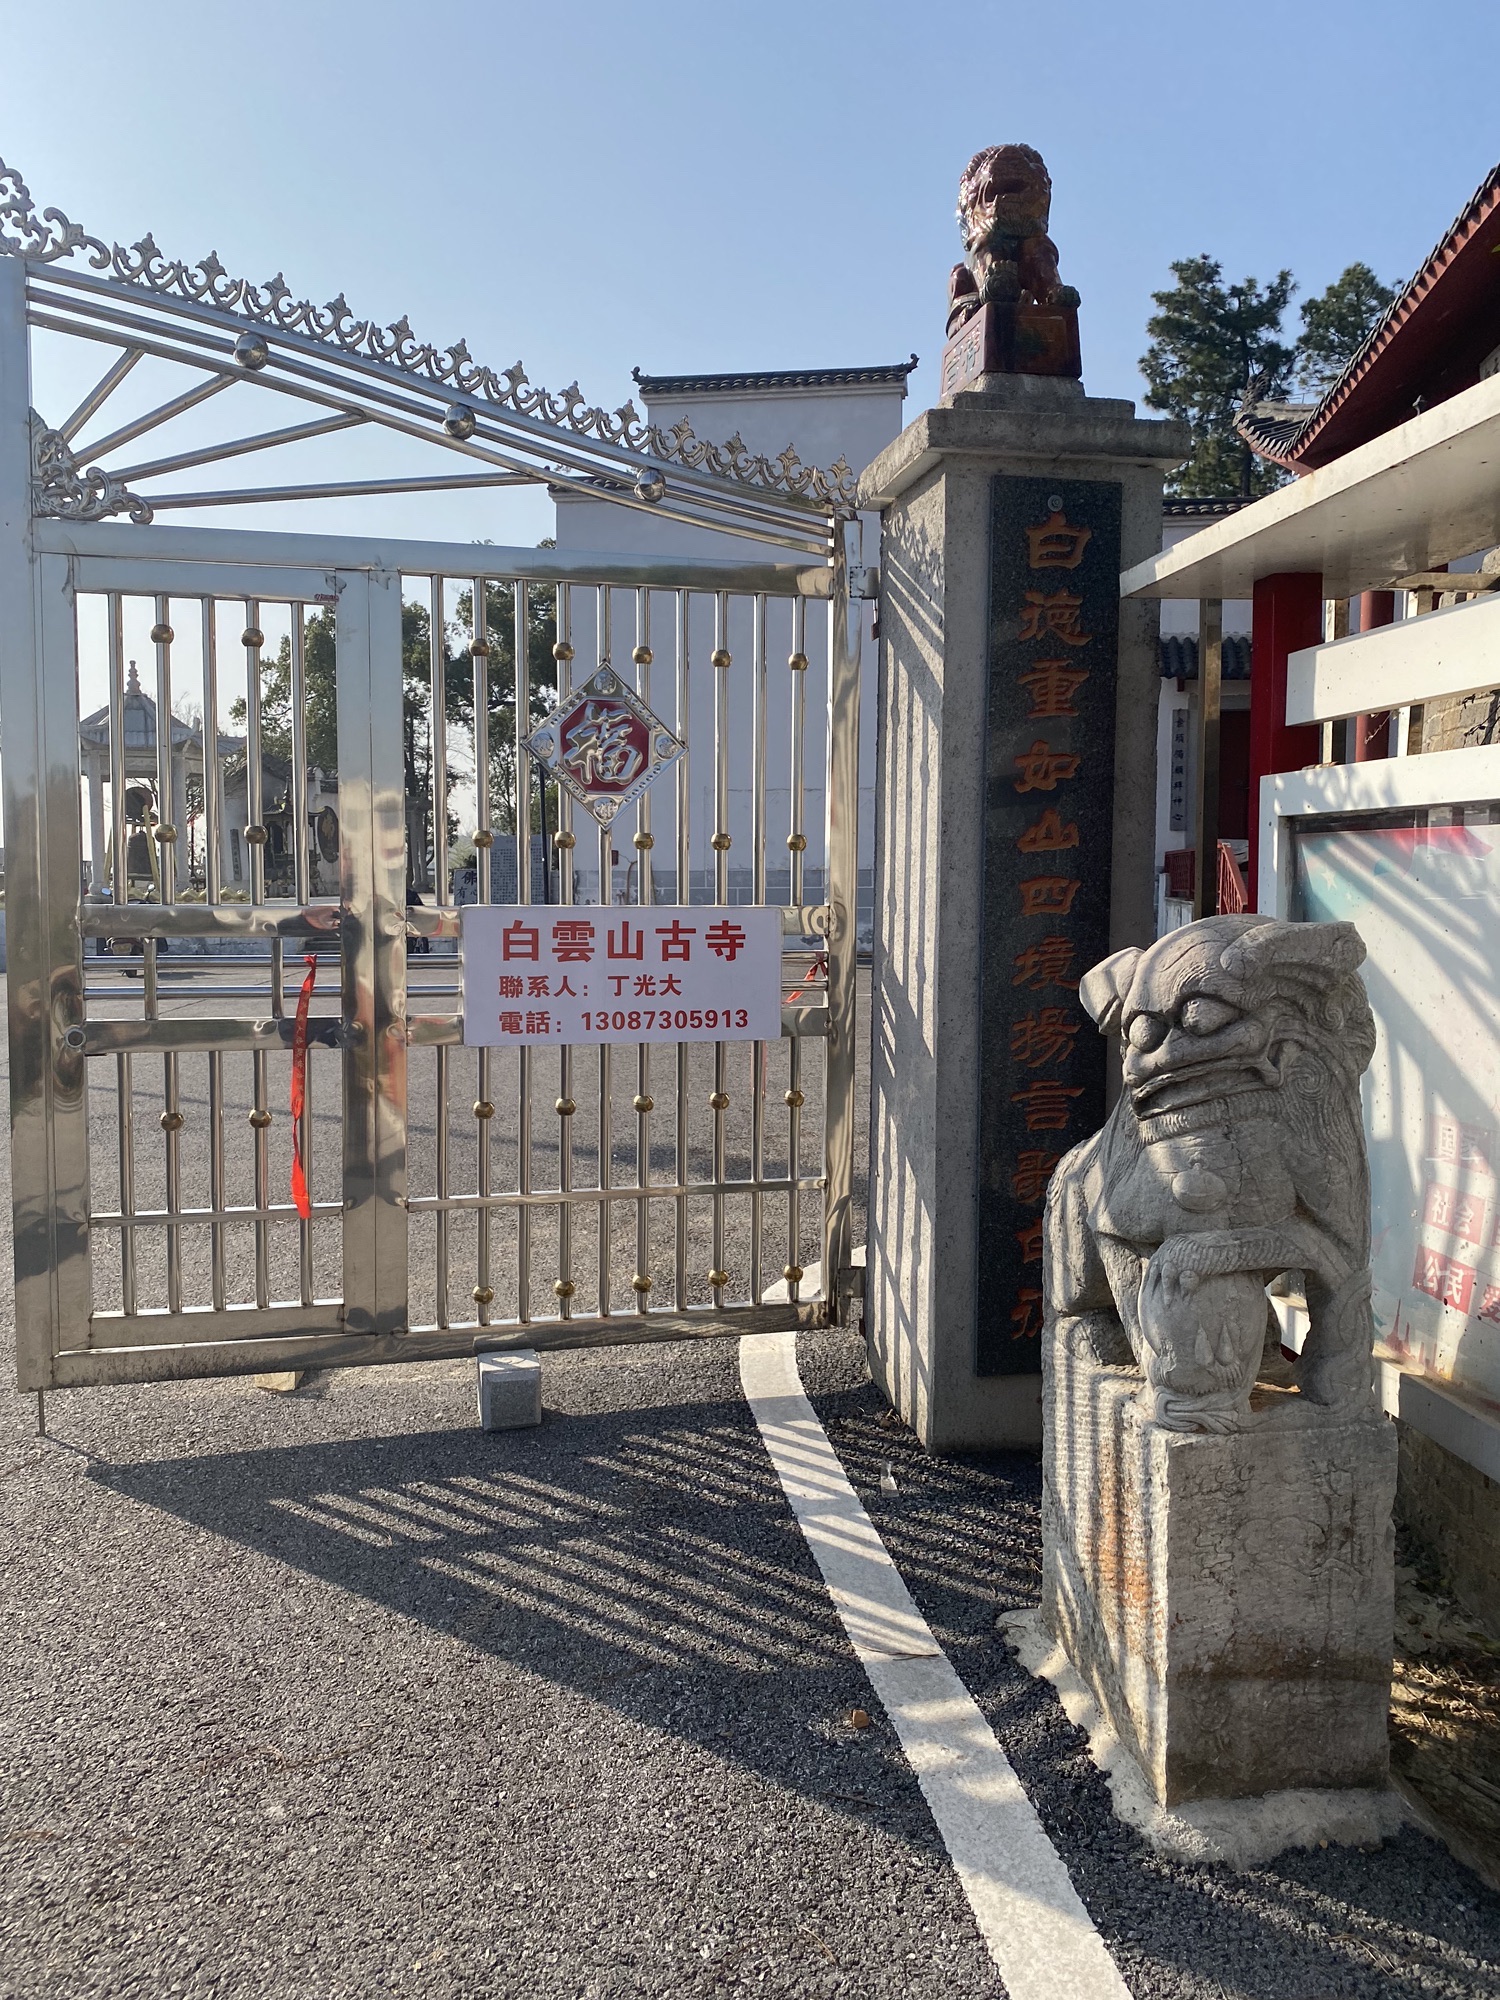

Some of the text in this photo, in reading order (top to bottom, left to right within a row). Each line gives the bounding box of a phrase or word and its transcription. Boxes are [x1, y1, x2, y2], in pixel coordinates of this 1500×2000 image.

[563, 702, 643, 785] 福
[502, 919, 747, 963] 白雲山古寺
[1431, 1189, 1475, 1236] 社会
[1422, 1255, 1465, 1305] 公民
